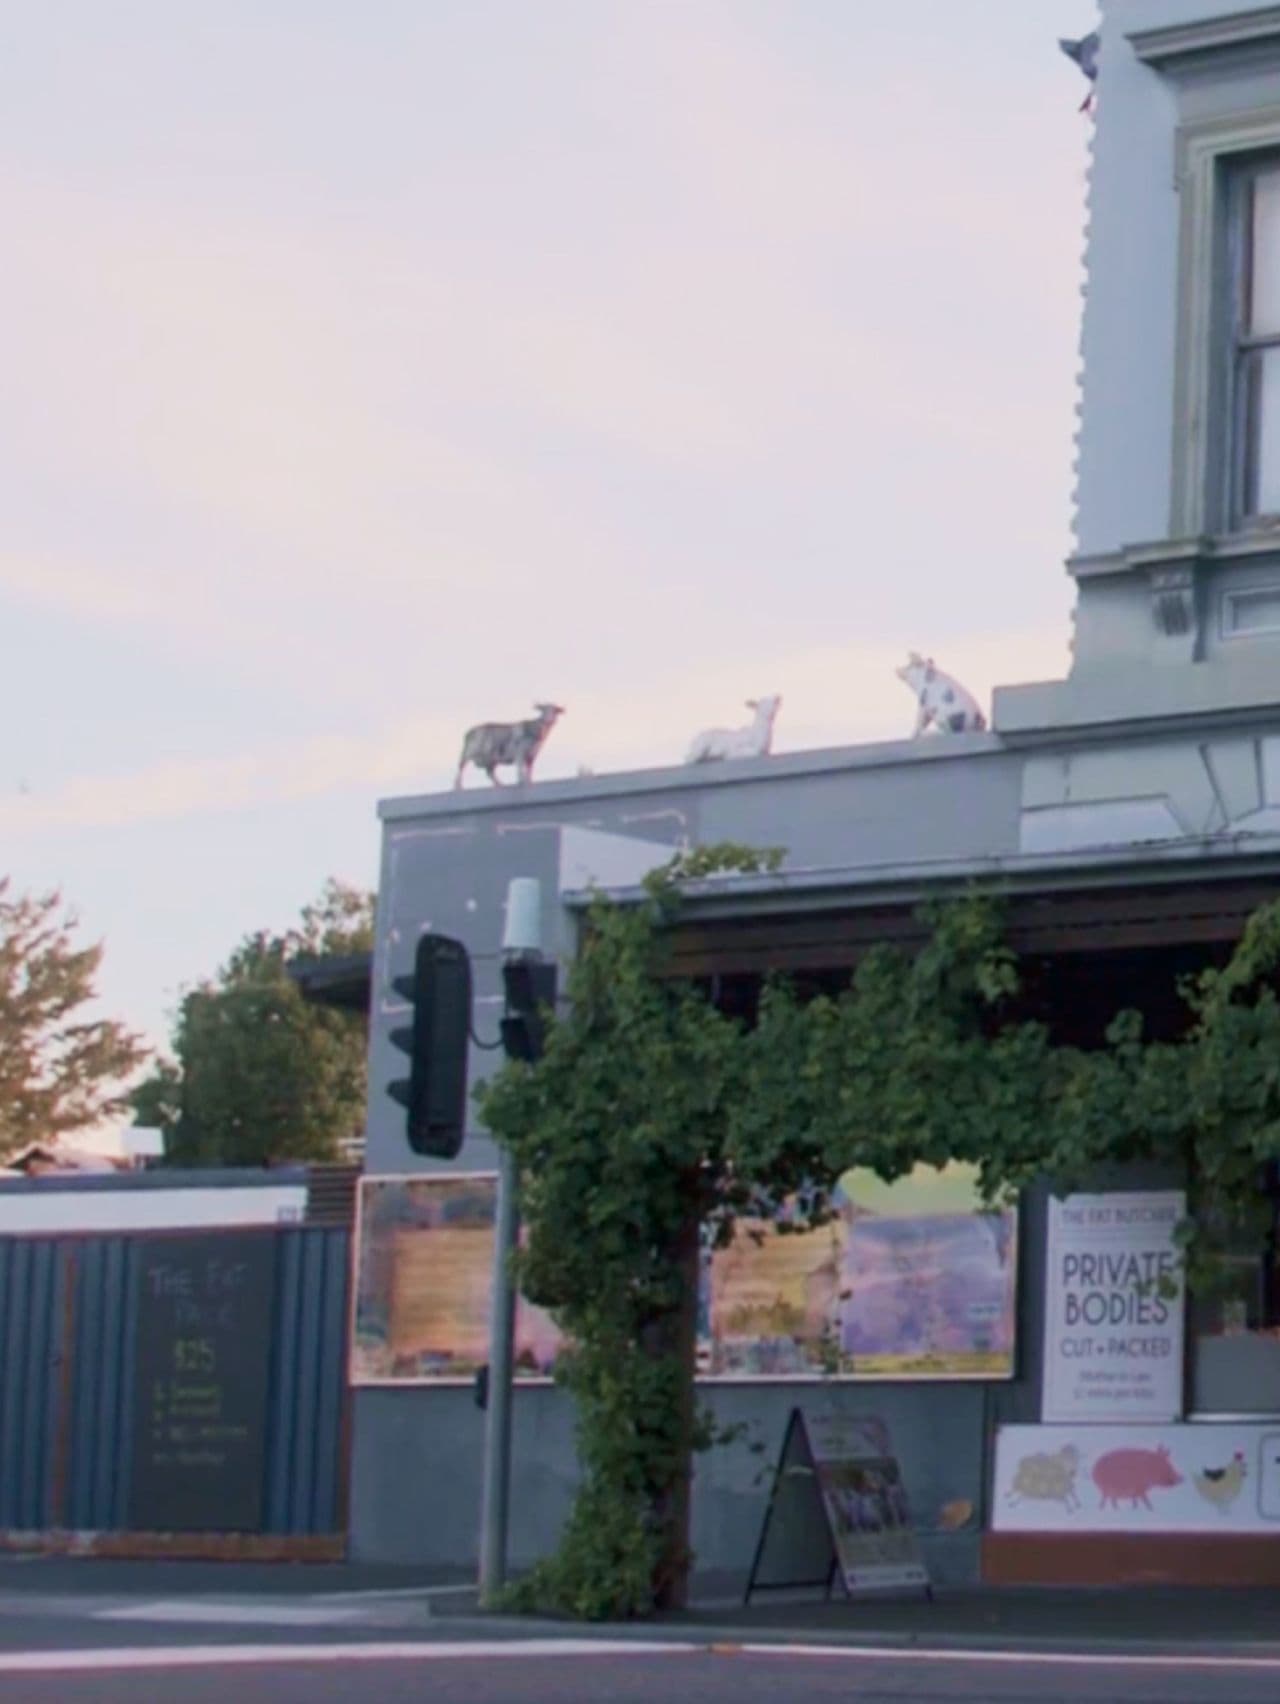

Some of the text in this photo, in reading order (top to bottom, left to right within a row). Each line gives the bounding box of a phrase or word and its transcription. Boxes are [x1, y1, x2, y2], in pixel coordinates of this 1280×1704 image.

[1088, 1207, 1112, 1224] FAT
[1062, 1251, 1173, 1289] PRIVATE
[1065, 1292, 1170, 1327] BODIES
[1060, 1336, 1094, 1359] CUT
[1107, 1335, 1172, 1359] PACKED
